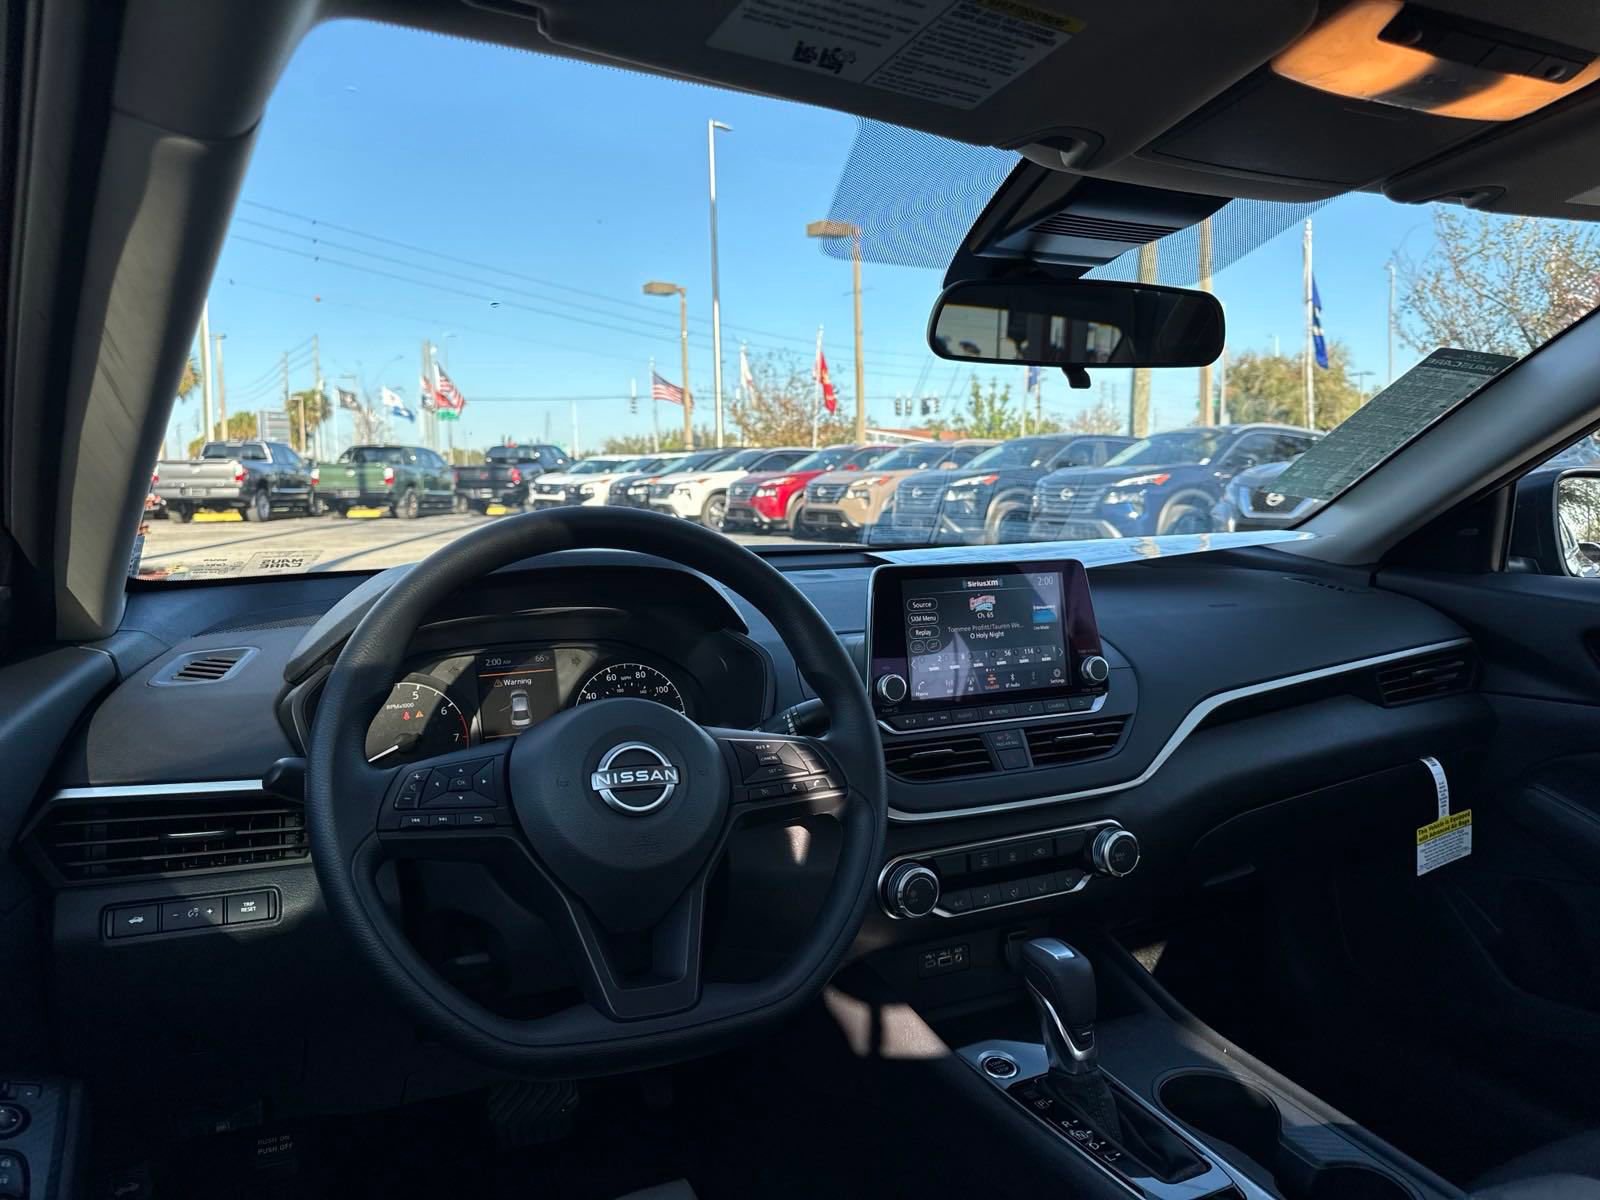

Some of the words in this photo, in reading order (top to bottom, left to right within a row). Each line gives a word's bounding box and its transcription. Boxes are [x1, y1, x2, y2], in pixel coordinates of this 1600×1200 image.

[1037, 576, 1054, 586] 2:00
[912, 601, 932, 609] Source
[923, 614, 937, 622] Menu
[915, 629, 932, 638] Replay
[976, 632, 988, 640] Holy
[989, 631, 1005, 639] Night
[485, 657, 502, 666] 2:00
[606, 674, 617, 682] 60
[635, 671, 646, 679] 80
[503, 678, 532, 687] Warning
[655, 686, 669, 694] 100
[412, 691, 420, 700] 5
[586, 692, 597, 700] 40
[440, 707, 448, 716] 6
[452, 733, 460, 742] 7
[596, 769, 677, 785] NISSAN
